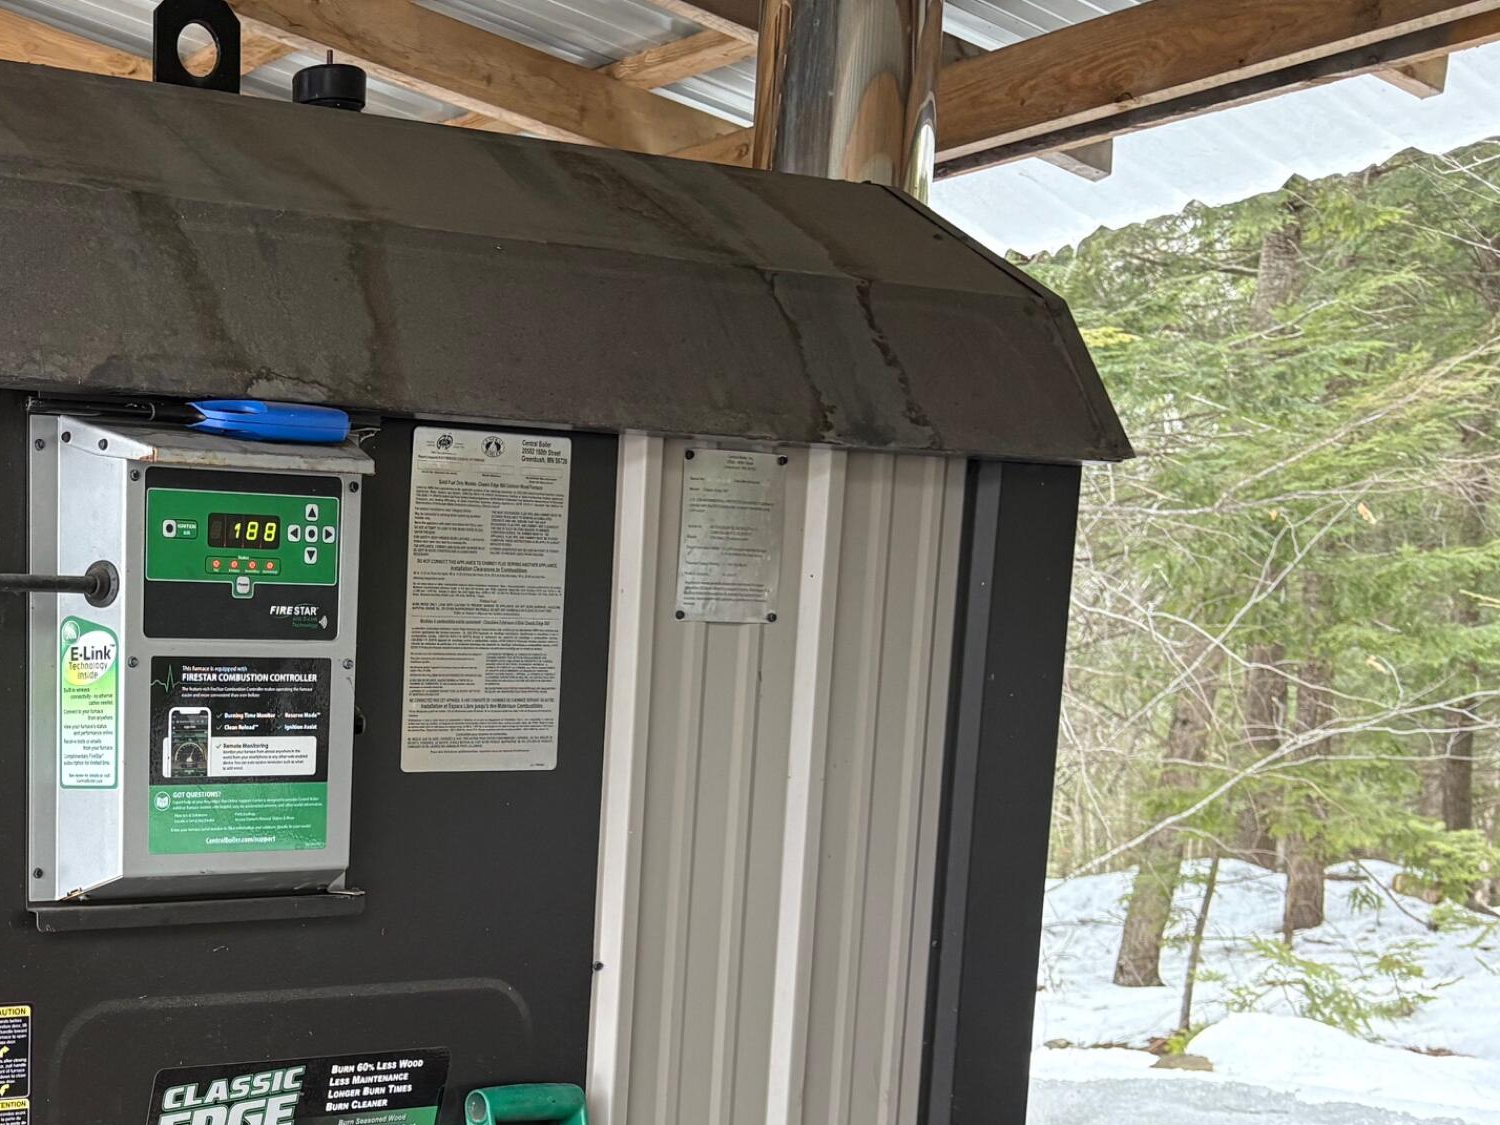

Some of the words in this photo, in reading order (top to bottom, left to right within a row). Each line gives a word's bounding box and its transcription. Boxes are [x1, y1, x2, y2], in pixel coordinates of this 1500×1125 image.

[234, 521, 276, 542] 188
[270, 606, 317, 615] FIRESTAR
[69, 662, 107, 671] Technology
[182, 673, 216, 682] FIRESTAR
[218, 673, 268, 682] COMBUSTION
[270, 674, 317, 682] CONTROLLER
[357, 1062, 375, 1072] 60%
[376, 1062, 396, 1070] LESS
[329, 1077, 350, 1086] LESS
[162, 1065, 306, 1111] CLASSIC
[356, 1116, 387, 1125] Seasoned
[388, 1113, 406, 1121] Wood
